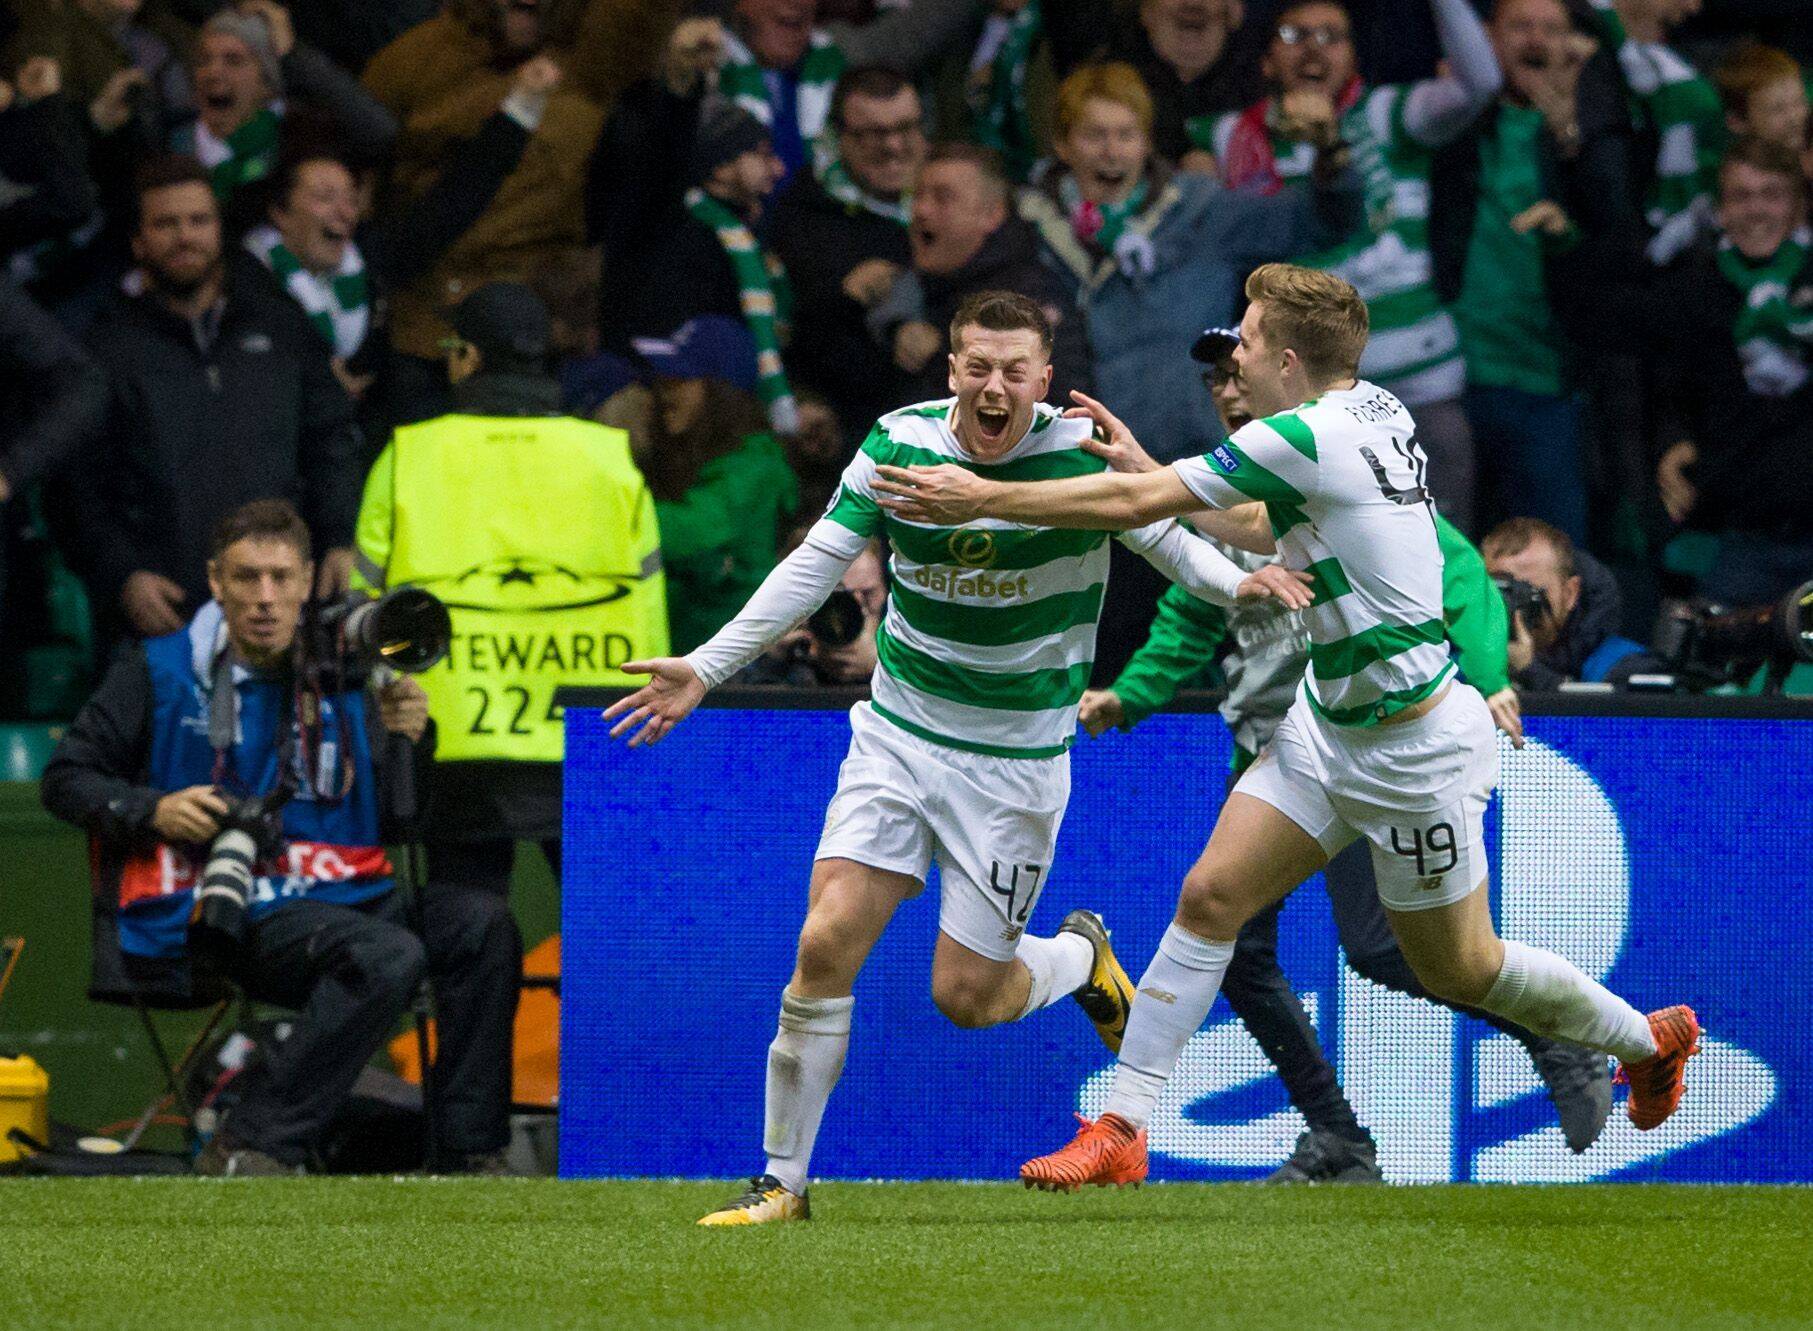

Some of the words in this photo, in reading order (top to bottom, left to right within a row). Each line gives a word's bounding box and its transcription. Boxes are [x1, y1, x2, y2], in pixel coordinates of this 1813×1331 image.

[914, 563, 1029, 600] dafabet
[446, 632, 634, 672] TEWARD
[1390, 821, 1459, 877] 49
